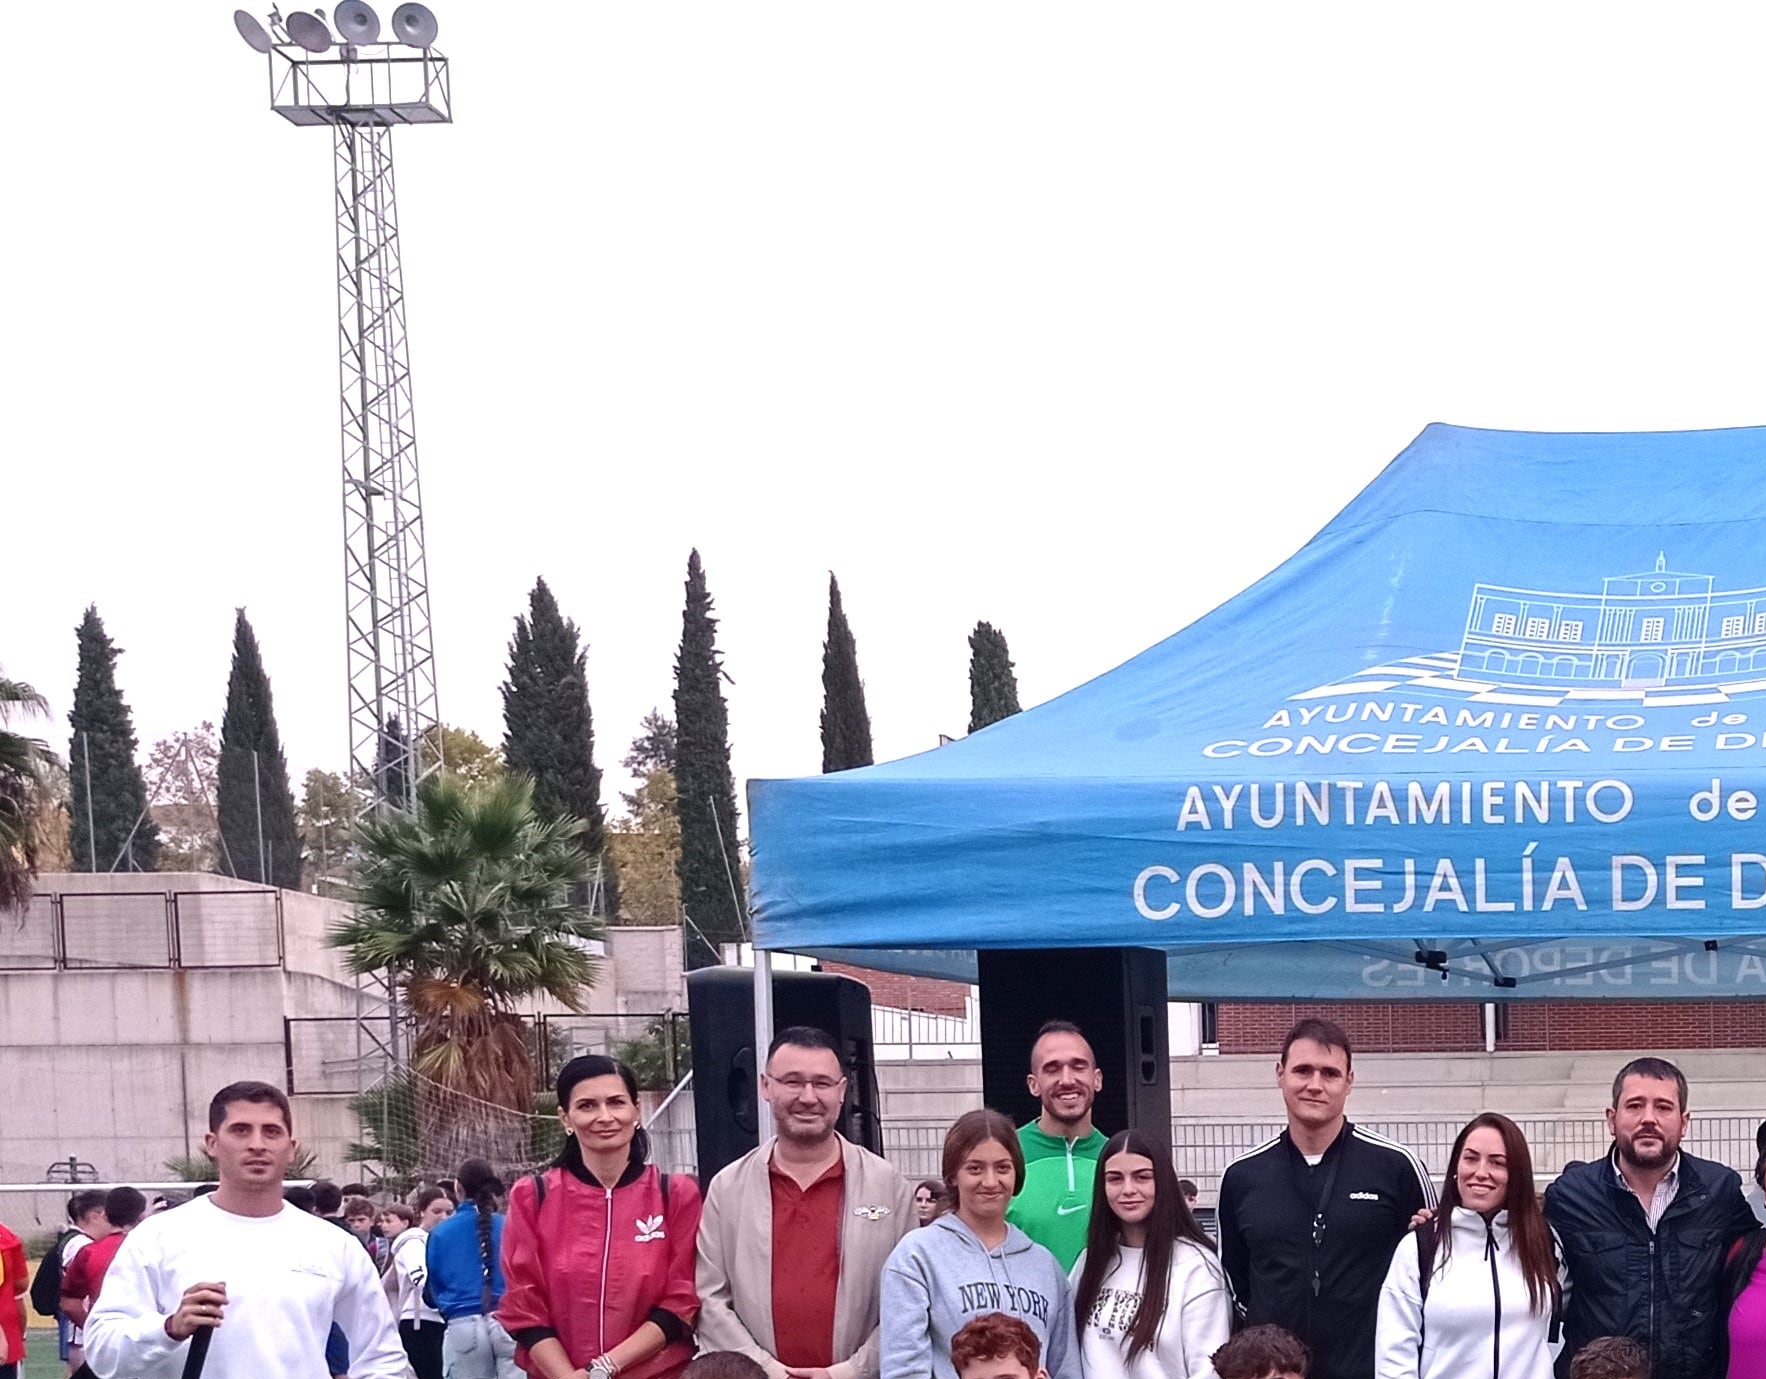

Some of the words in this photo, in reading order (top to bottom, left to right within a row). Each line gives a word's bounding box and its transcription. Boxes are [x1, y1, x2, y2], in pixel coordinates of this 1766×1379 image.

[1262, 701, 1646, 731] AYUNTAMIENTO
[1690, 710, 1749, 728] de
[1202, 733, 1591, 758] CONCEJALÍA
[1613, 735, 1696, 753] DE
[1176, 779, 1635, 832] AYUNTAMIENTO
[1688, 778, 1759, 822] de
[1133, 841, 1589, 921] CONCEJALÍA
[1610, 854, 1707, 911] DE
[1350, 1191, 1379, 1201] adidas
[958, 1282, 1001, 1314] NEW
